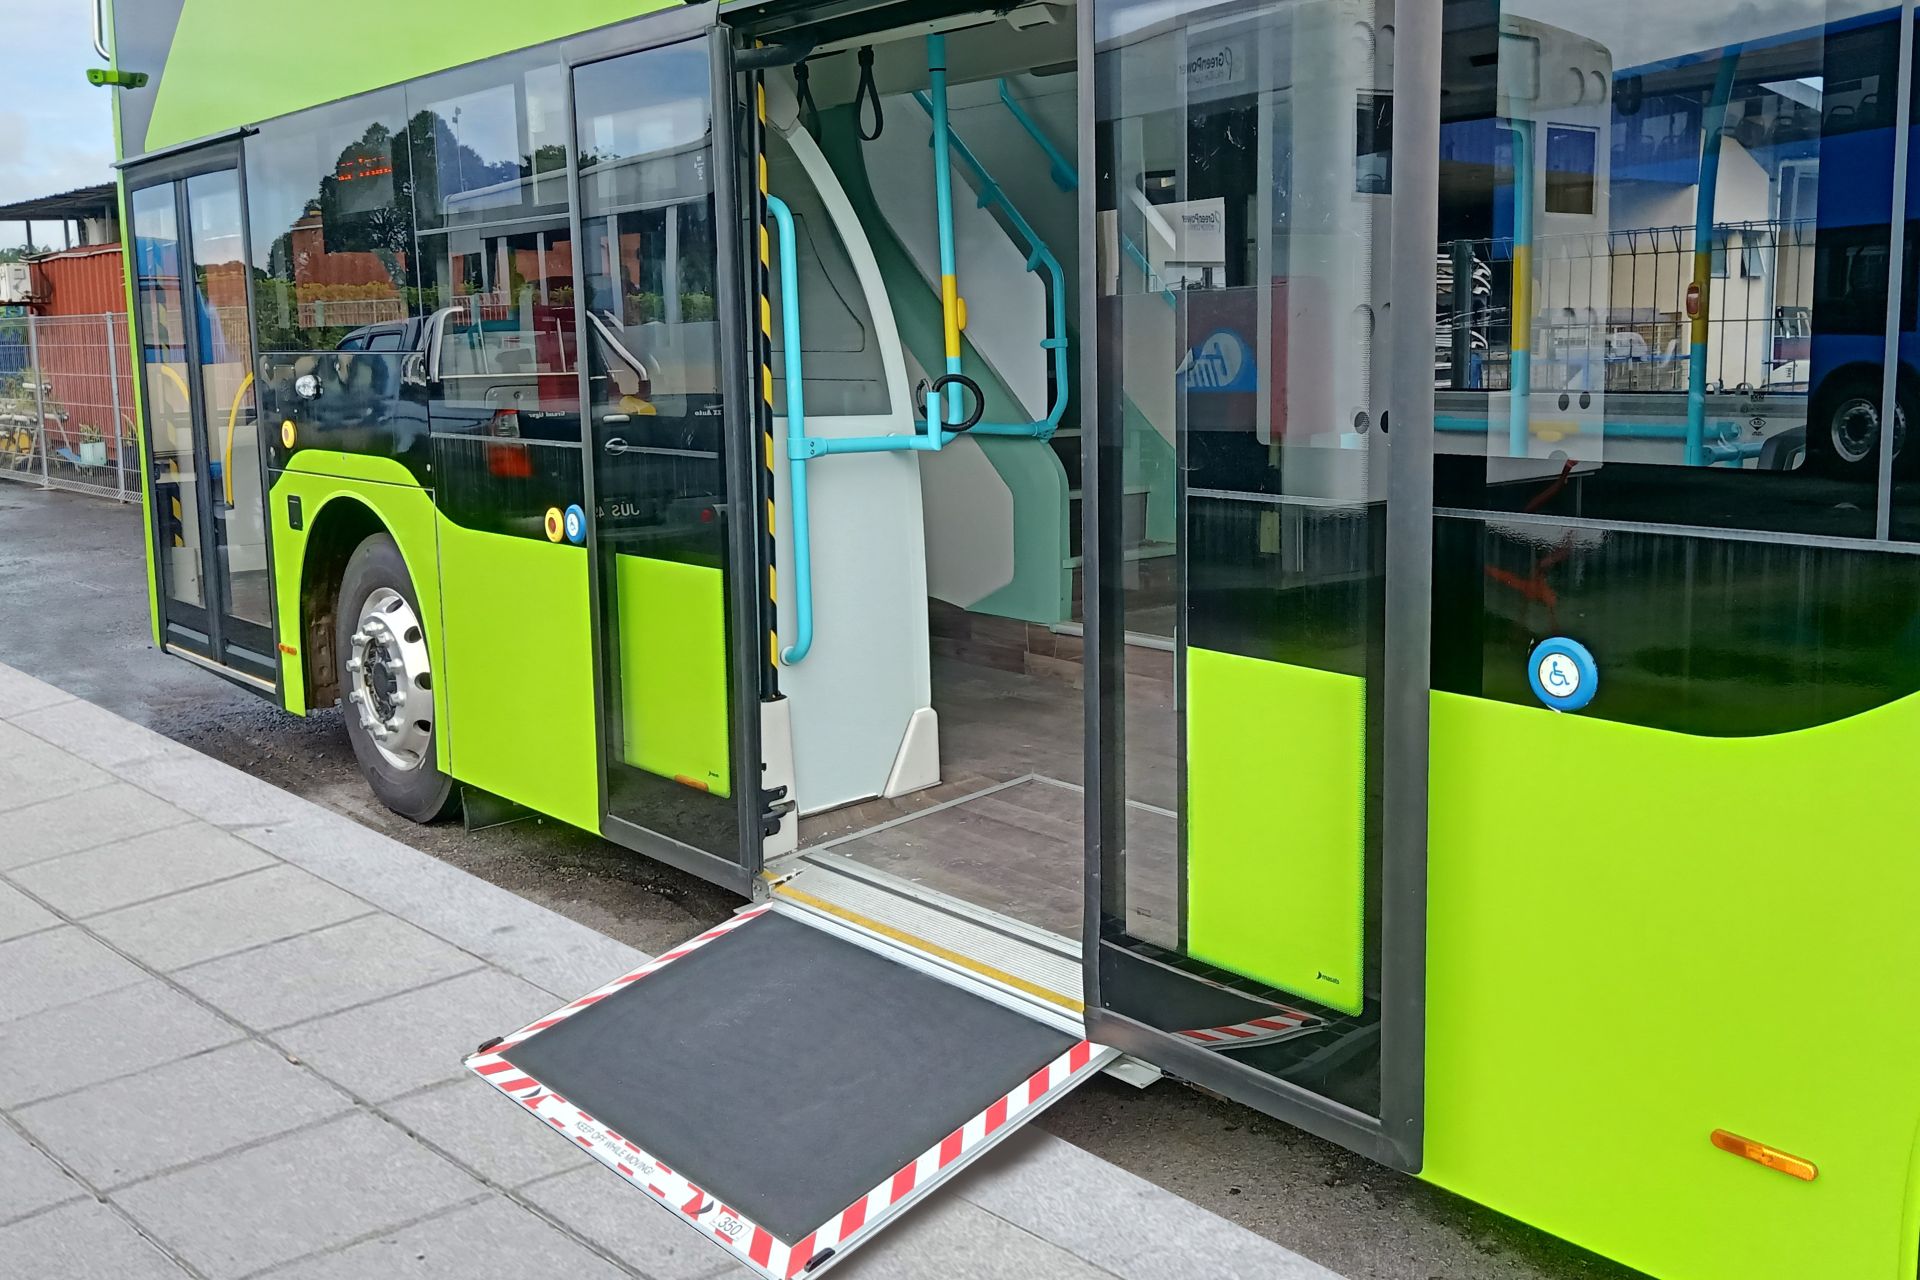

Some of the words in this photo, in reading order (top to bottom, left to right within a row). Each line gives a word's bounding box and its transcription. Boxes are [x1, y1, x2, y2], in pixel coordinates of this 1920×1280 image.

[575, 1120, 595, 1134] KEEP
[591, 1131, 608, 1142] OFF
[604, 1140, 627, 1157] WHILE
[717, 1216, 743, 1236] 350
